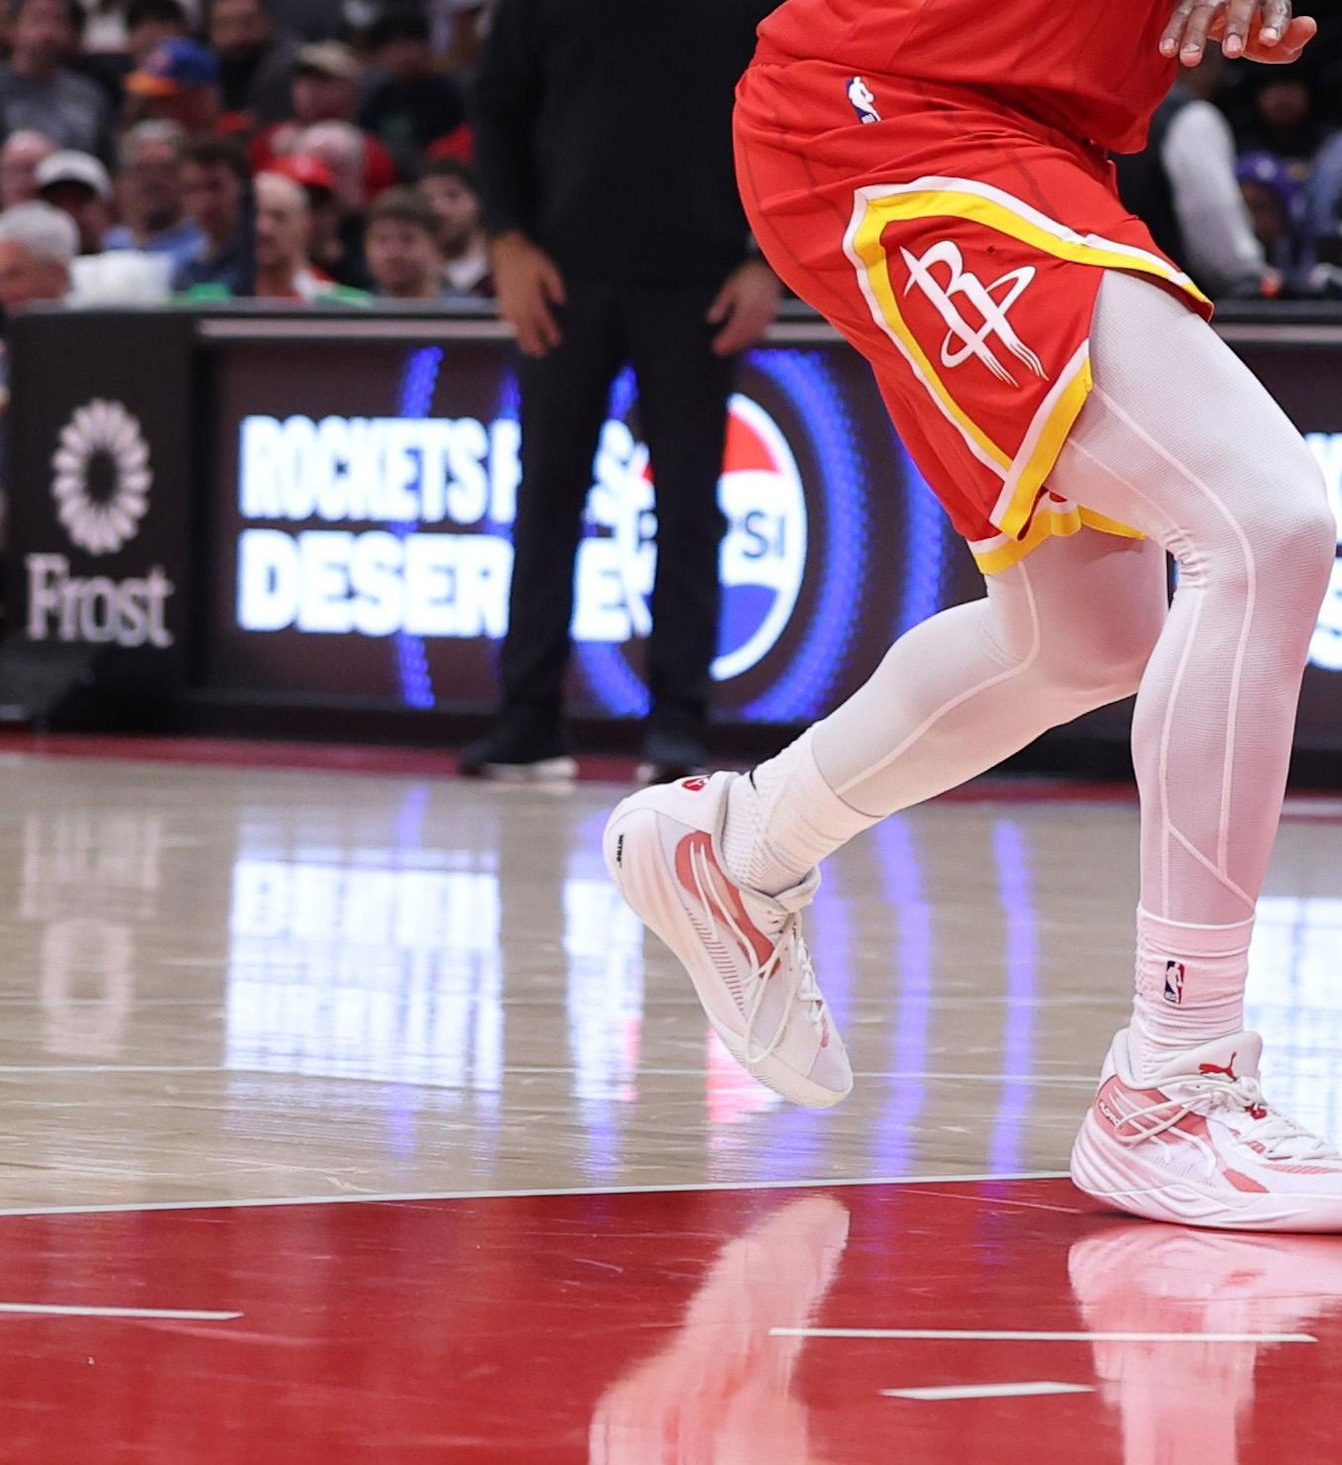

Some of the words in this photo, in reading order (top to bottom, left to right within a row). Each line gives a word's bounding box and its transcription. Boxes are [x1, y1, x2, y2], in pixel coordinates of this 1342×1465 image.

[239, 415, 489, 525] ROCKETS
[25, 553, 174, 647] Frost
[235, 528, 633, 644] DESERE
